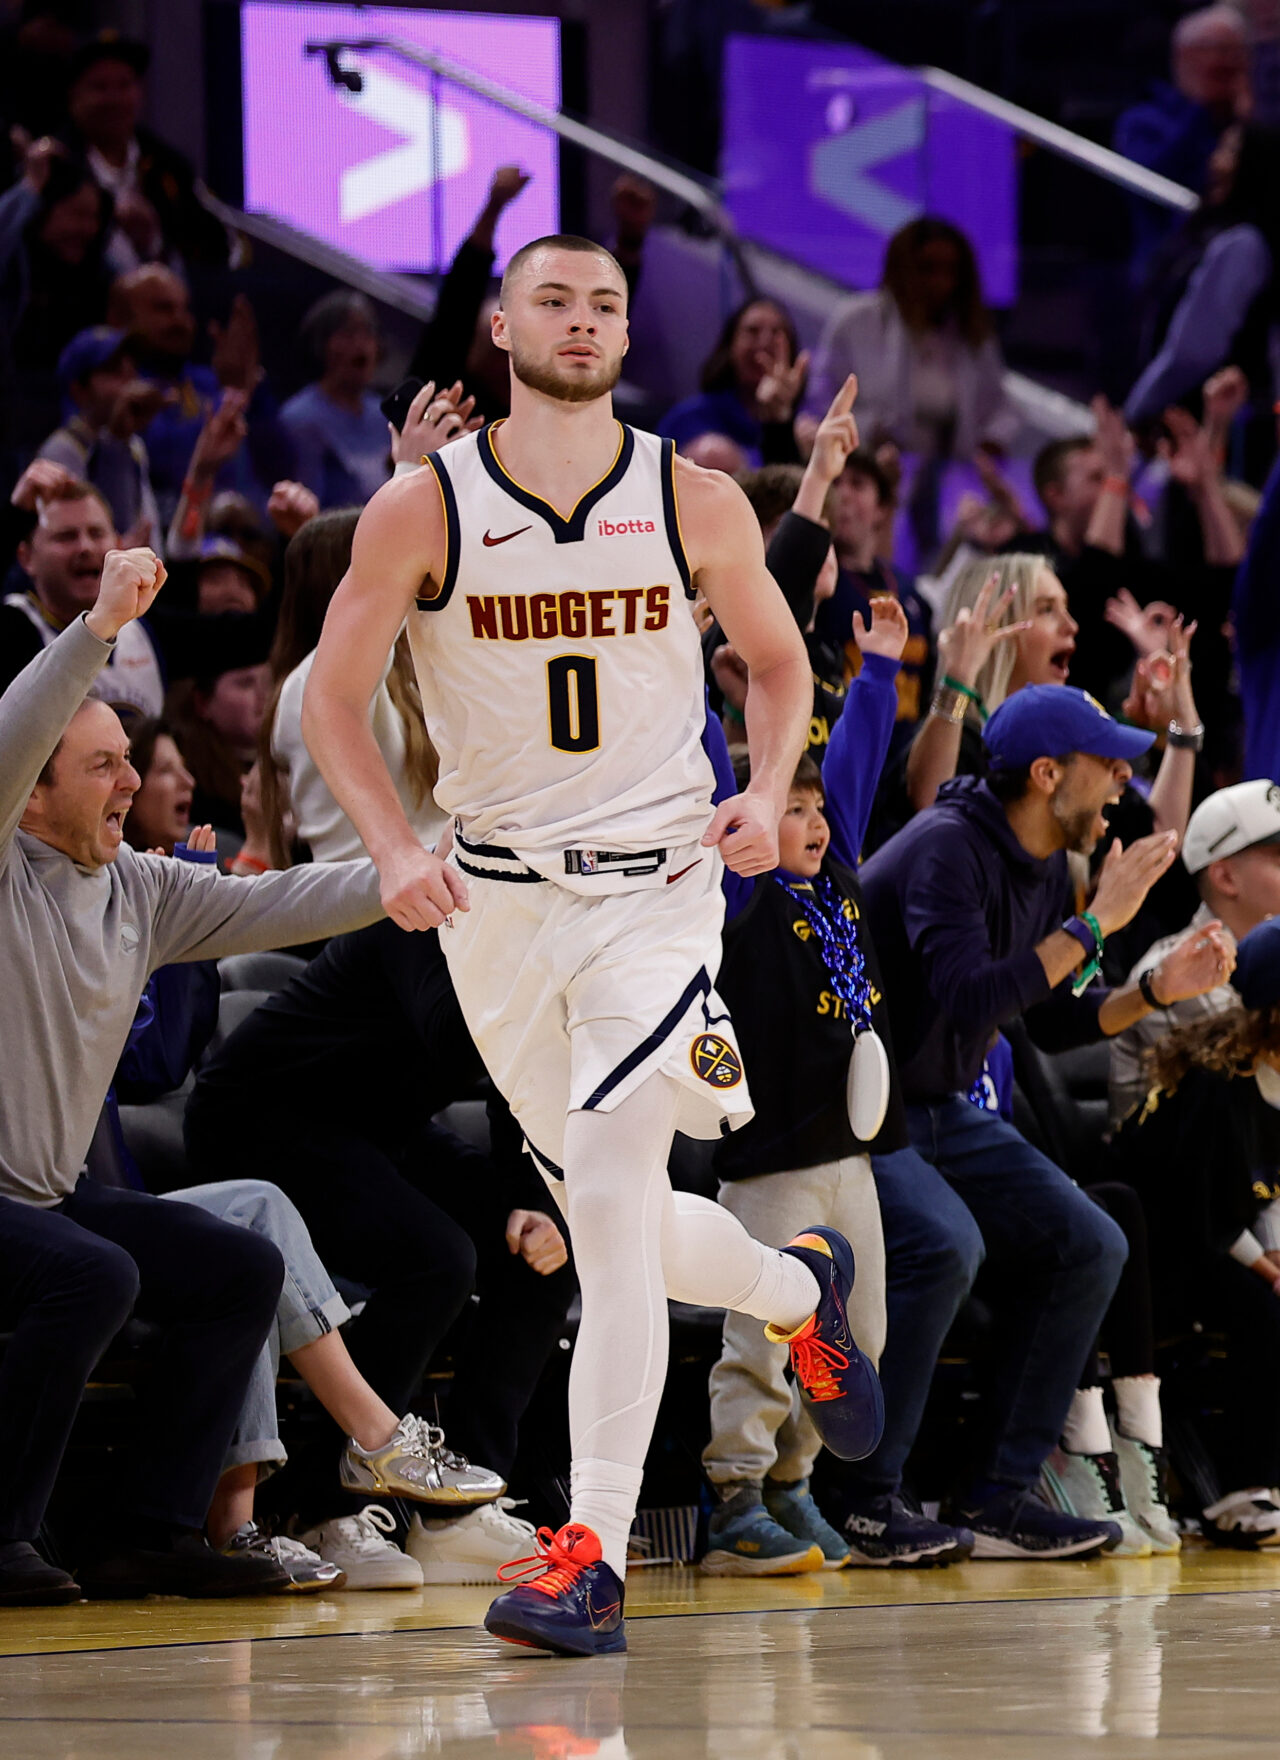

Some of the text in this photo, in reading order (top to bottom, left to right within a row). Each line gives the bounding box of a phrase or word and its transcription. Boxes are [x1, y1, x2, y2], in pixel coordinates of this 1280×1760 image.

[598, 520, 655, 536] ibotta
[466, 585, 670, 641] NUGGETS
[545, 653, 601, 754] 0
